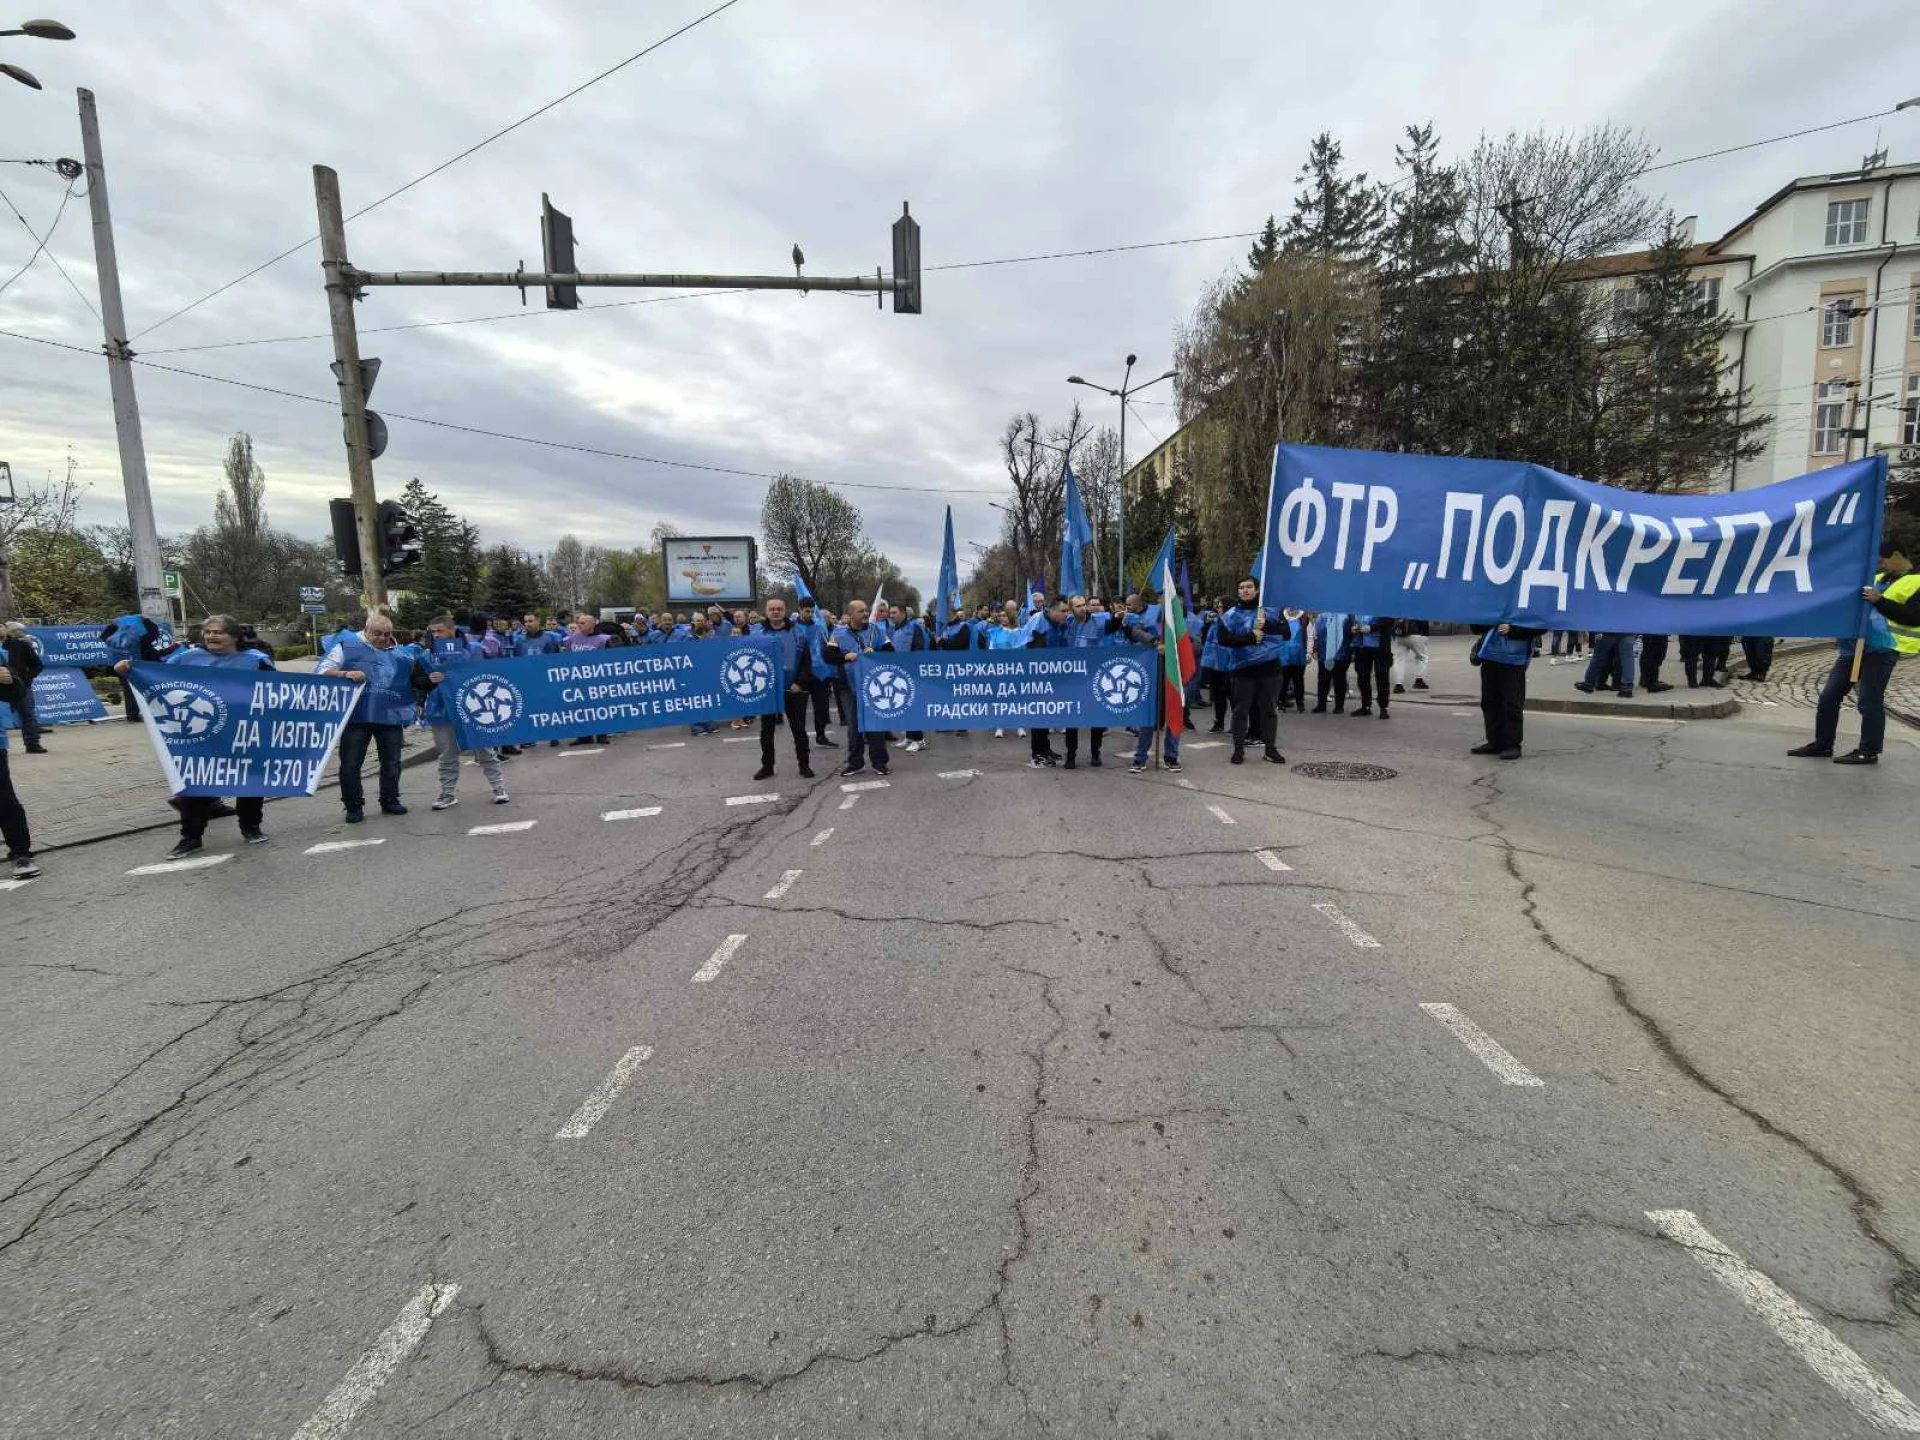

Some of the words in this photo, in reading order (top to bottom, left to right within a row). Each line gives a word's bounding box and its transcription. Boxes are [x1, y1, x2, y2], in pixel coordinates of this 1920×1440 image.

[1277, 476, 1398, 572] ФТР
[546, 654, 694, 683] ПРАВИТЕЛСТВАТА
[919, 664, 942, 677] БЕЗ
[945, 662, 1025, 680] ДЪРЖАВНА
[1029, 660, 1088, 676] ПОМОЩ
[562, 688, 585, 703] СА
[588, 677, 676, 700] ВРЕМЕННИ
[953, 682, 994, 697] НЯМА
[997, 682, 1017, 698] ДА
[1021, 681, 1054, 695] ИМА
[529, 701, 648, 728] ТРАНСПОРТЪТ
[653, 702, 662, 715] Е
[665, 694, 713, 713] ВЕЧЕН
[927, 702, 989, 719] ГРАДСКИ
[992, 701, 1073, 716] ТРАНСПОРТ
[231, 719, 261, 755] ДА
[263, 759, 302, 787] 1370
